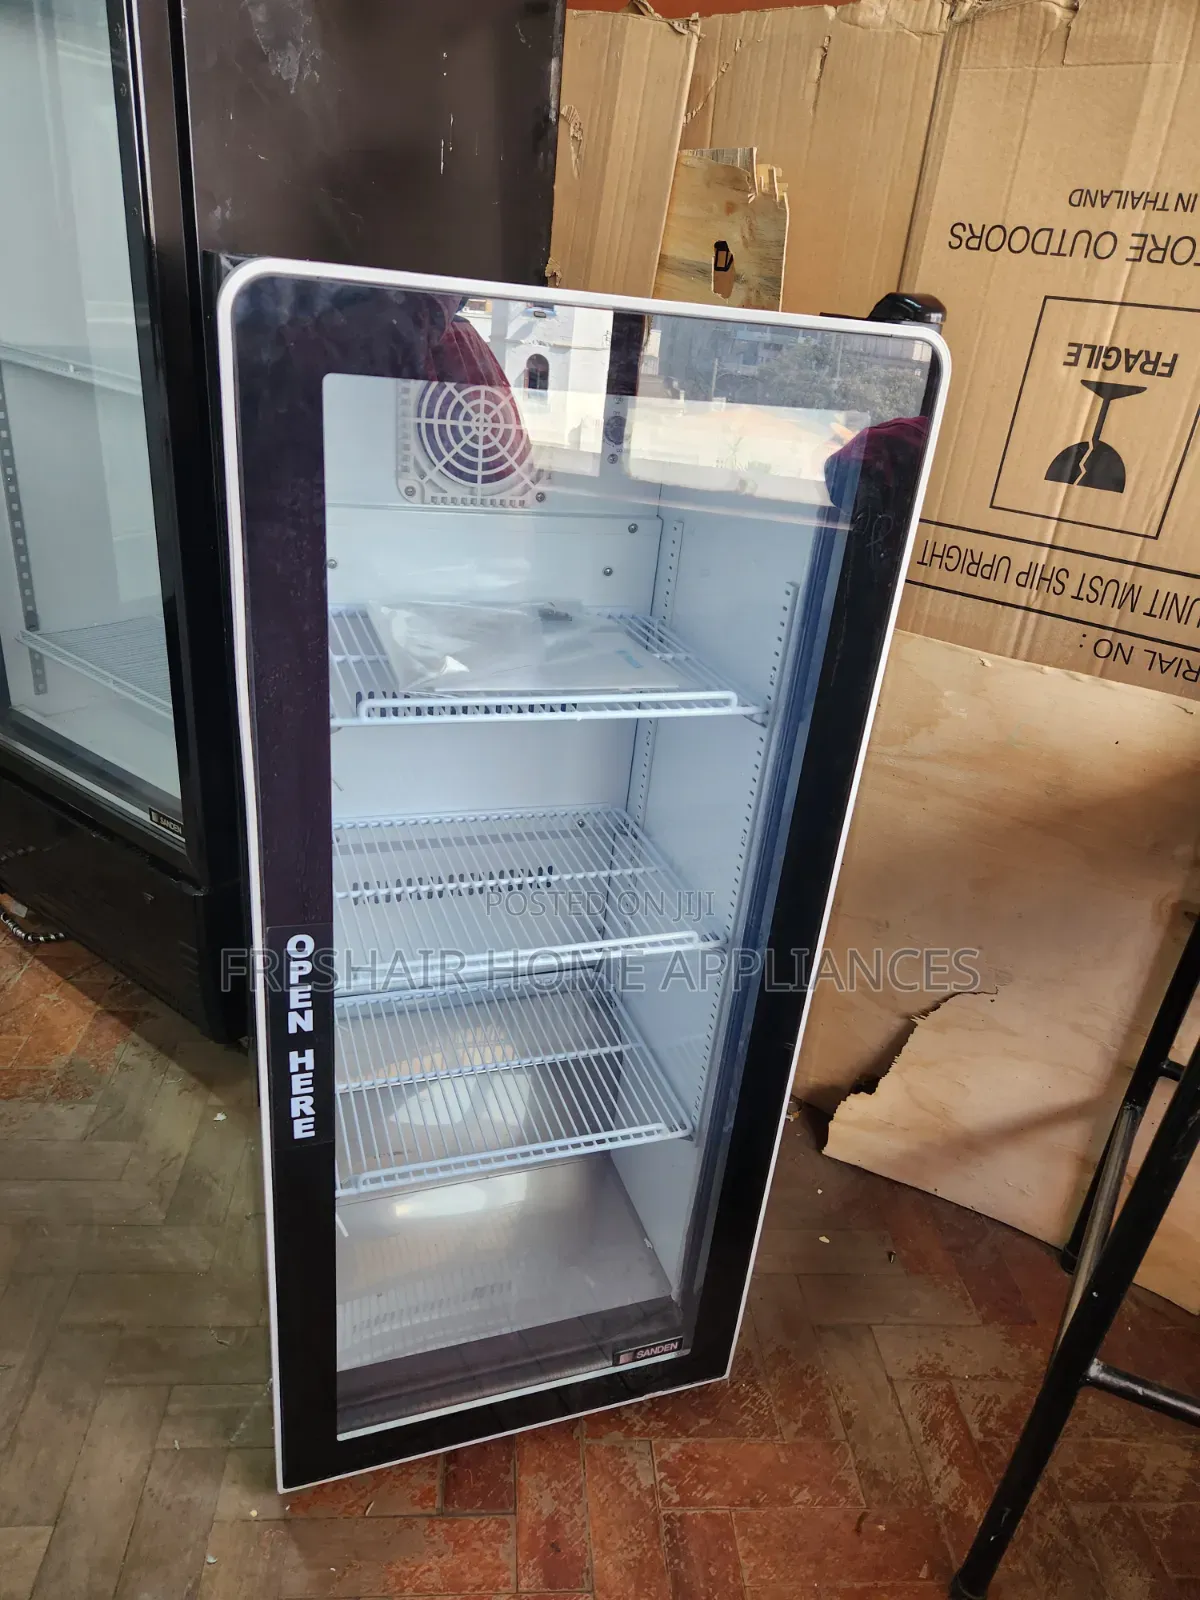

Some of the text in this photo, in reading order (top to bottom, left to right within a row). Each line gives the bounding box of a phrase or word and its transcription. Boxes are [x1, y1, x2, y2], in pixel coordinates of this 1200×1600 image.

[1068, 188, 1199, 214] IN THAILAND
[948, 222, 1200, 267] ORE OUTDOORS
[1062, 342, 1179, 378] FRAGILE
[916, 539, 1012, 584] UPRIGHT
[1015, 561, 1070, 596] SHIP
[1071, 573, 1143, 614] MUST
[1093, 637, 1135, 666] NO
[286, 933, 316, 1140] OPEN HERE
[635, 1341, 680, 1360] SANDEN
